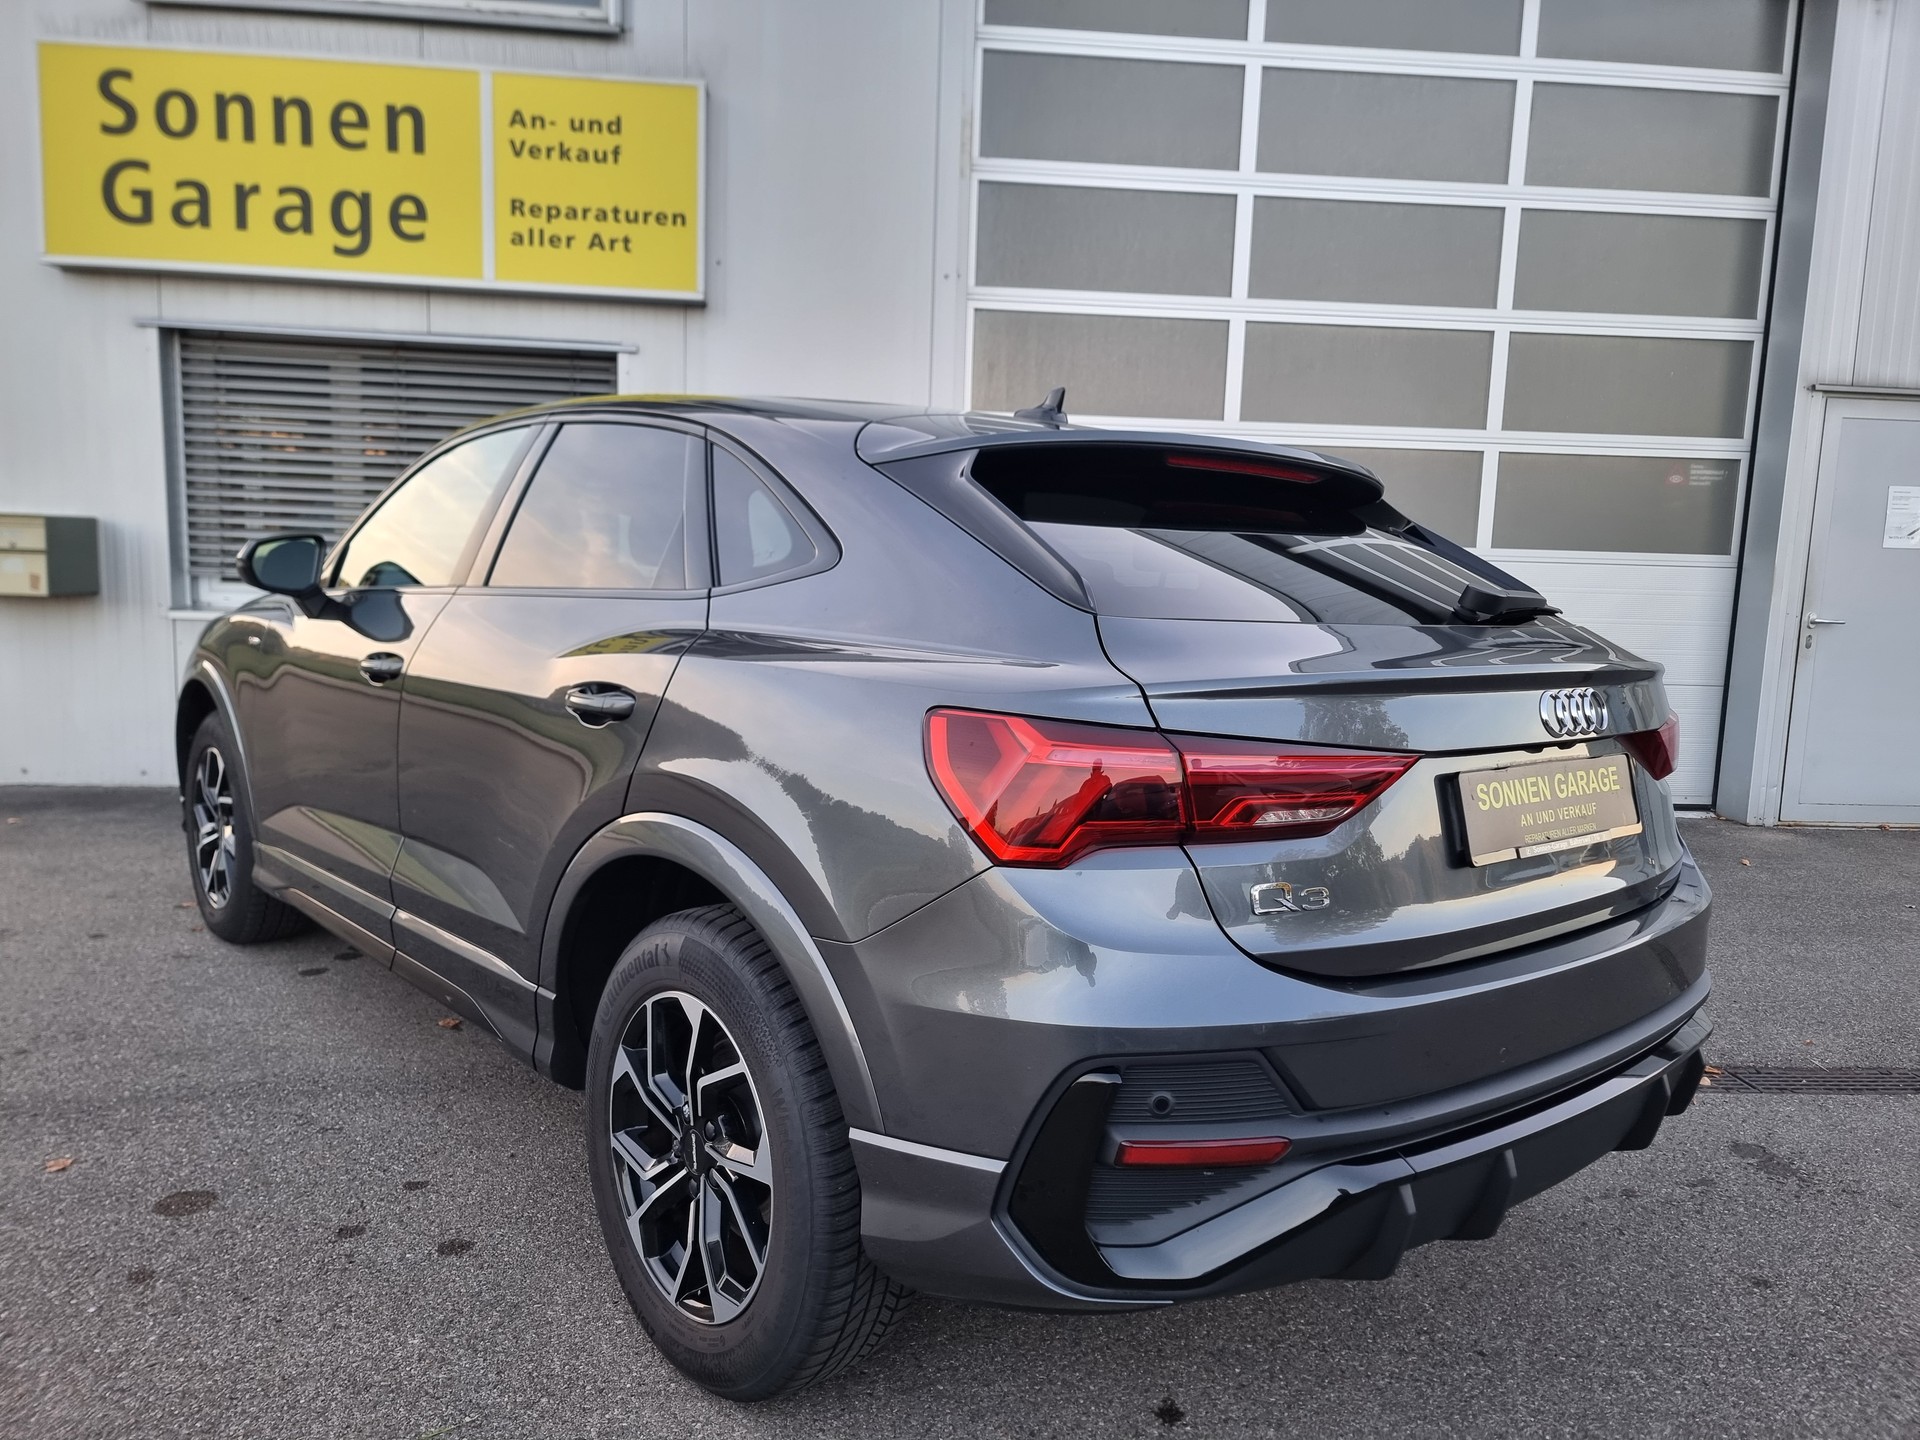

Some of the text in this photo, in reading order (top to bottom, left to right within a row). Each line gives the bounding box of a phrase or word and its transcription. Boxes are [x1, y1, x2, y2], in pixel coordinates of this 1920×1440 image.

[96, 67, 426, 156] Sonnen
[509, 109, 622, 136] An- und
[509, 138, 622, 165] Verkauf
[100, 158, 428, 258] Garage
[510, 198, 687, 228] Reparaturen
[511, 227, 631, 253] aller Art
[1476, 766, 1620, 811] SONNEN GARAGE
[1521, 802, 1597, 827] AN UND VERKAUF
[1524, 822, 1597, 843] REPARATUREN ALLER MARKEN
[1250, 882, 1330, 916] Q3
